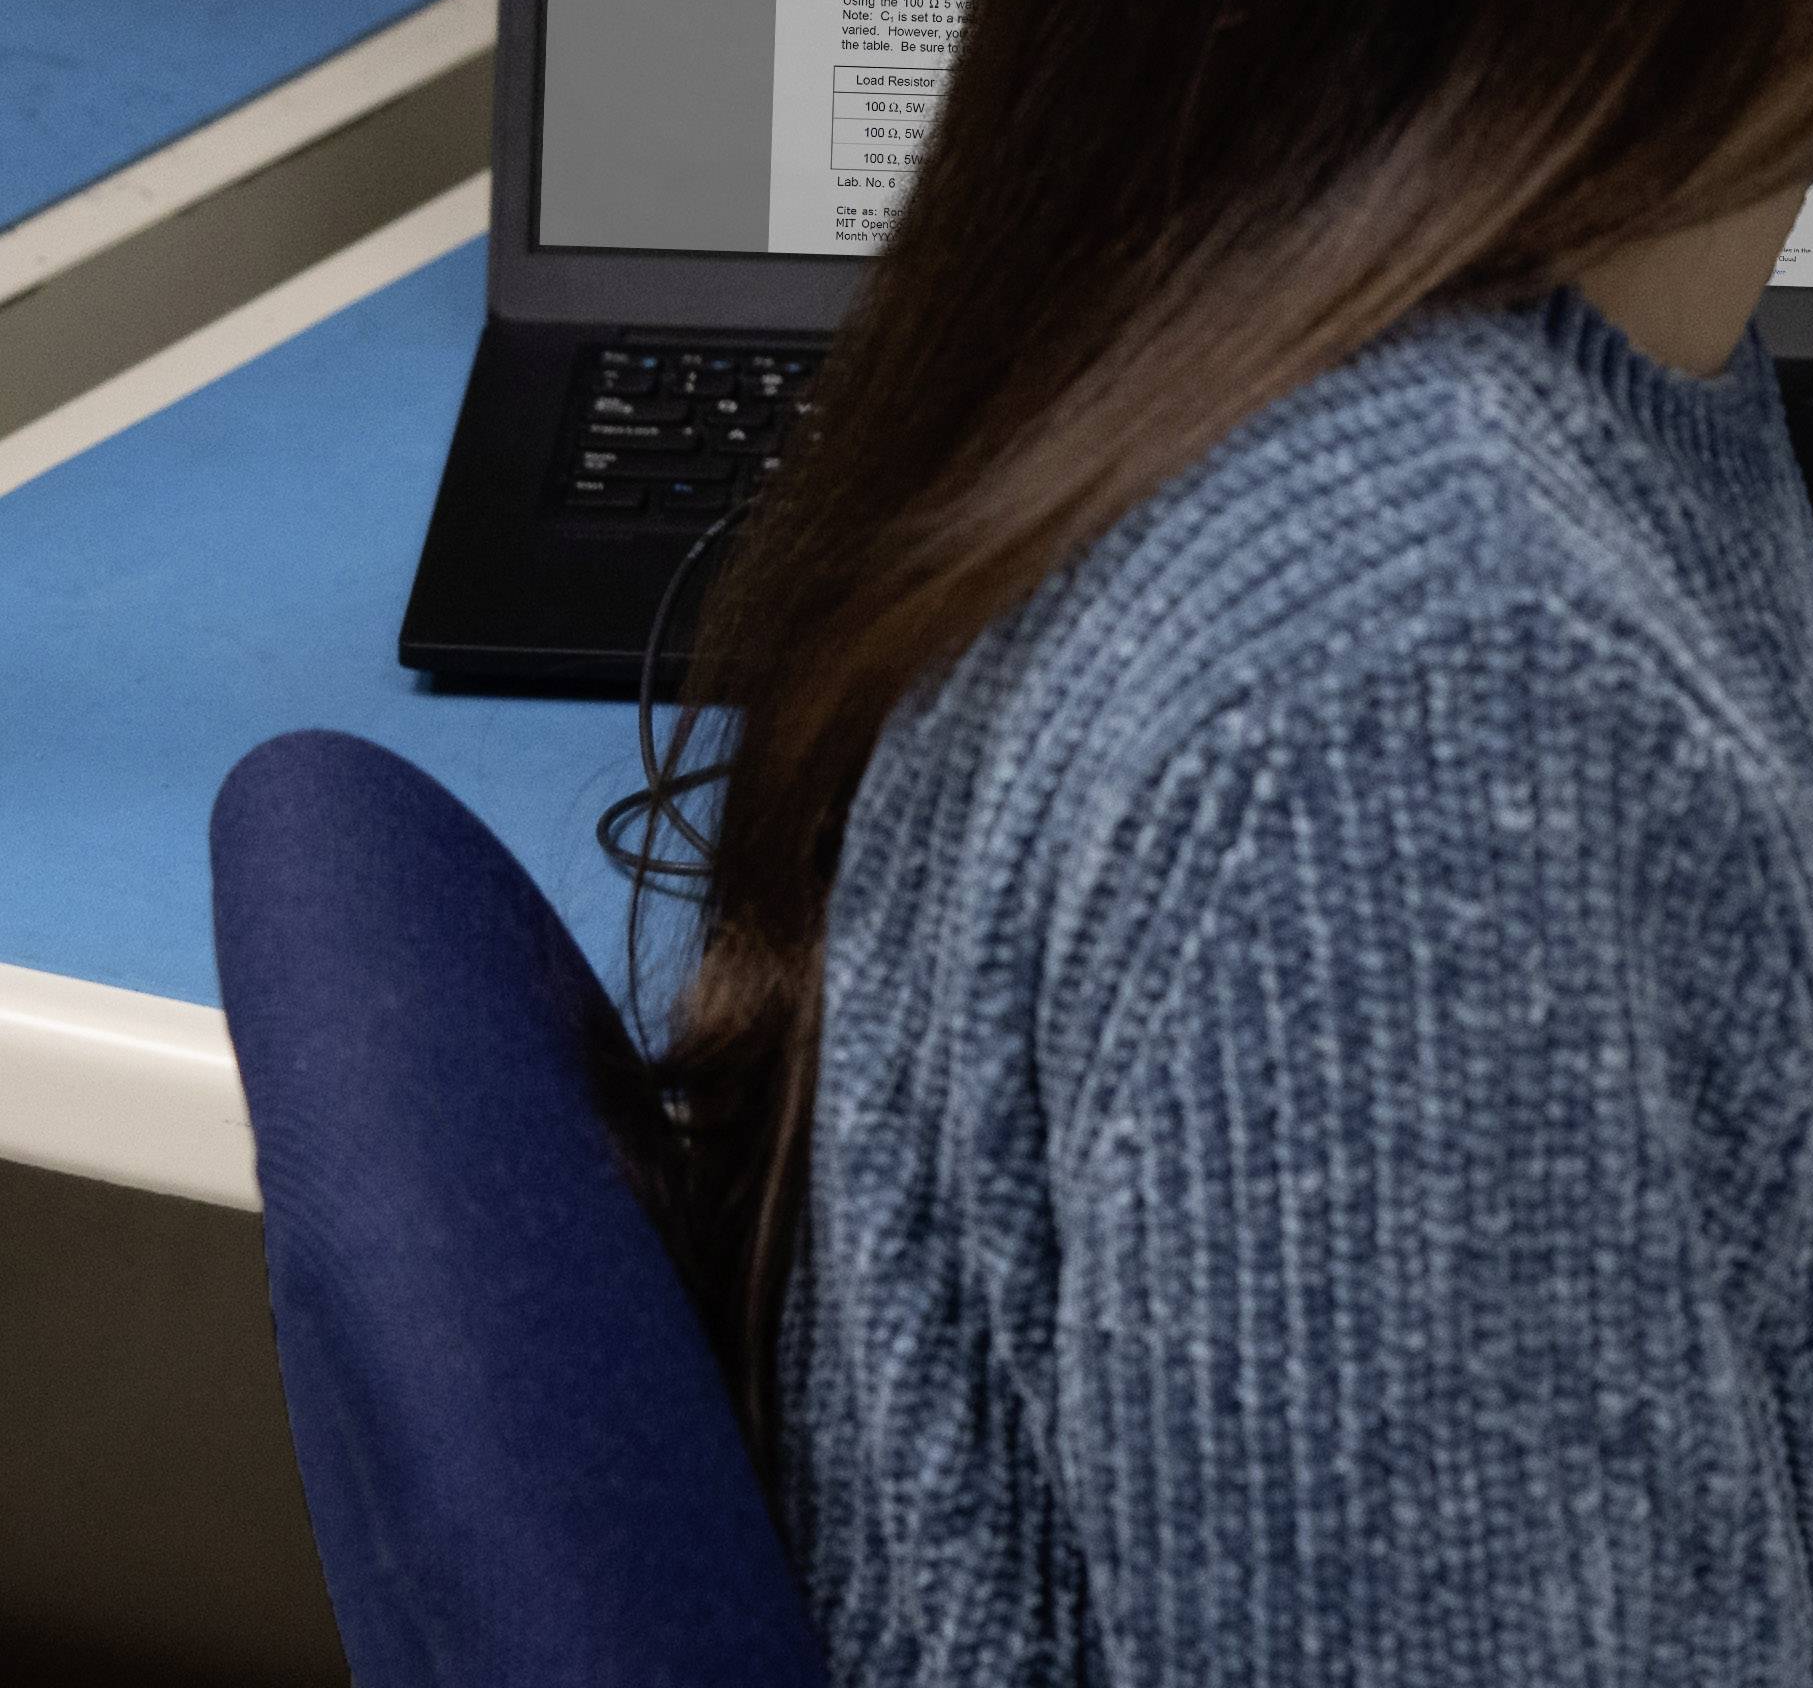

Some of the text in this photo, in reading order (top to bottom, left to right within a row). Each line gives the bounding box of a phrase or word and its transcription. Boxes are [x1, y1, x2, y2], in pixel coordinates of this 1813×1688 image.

[842, 25, 941, 39] varied. However,
[842, 40, 958, 53] the table. Be sure to
[856, 74, 936, 88] Load Resistor
[865, 102, 886, 112] 100
[906, 103, 925, 113] 5W
[837, 176, 896, 188] Lab. No. 6
[836, 231, 868, 241] Month
